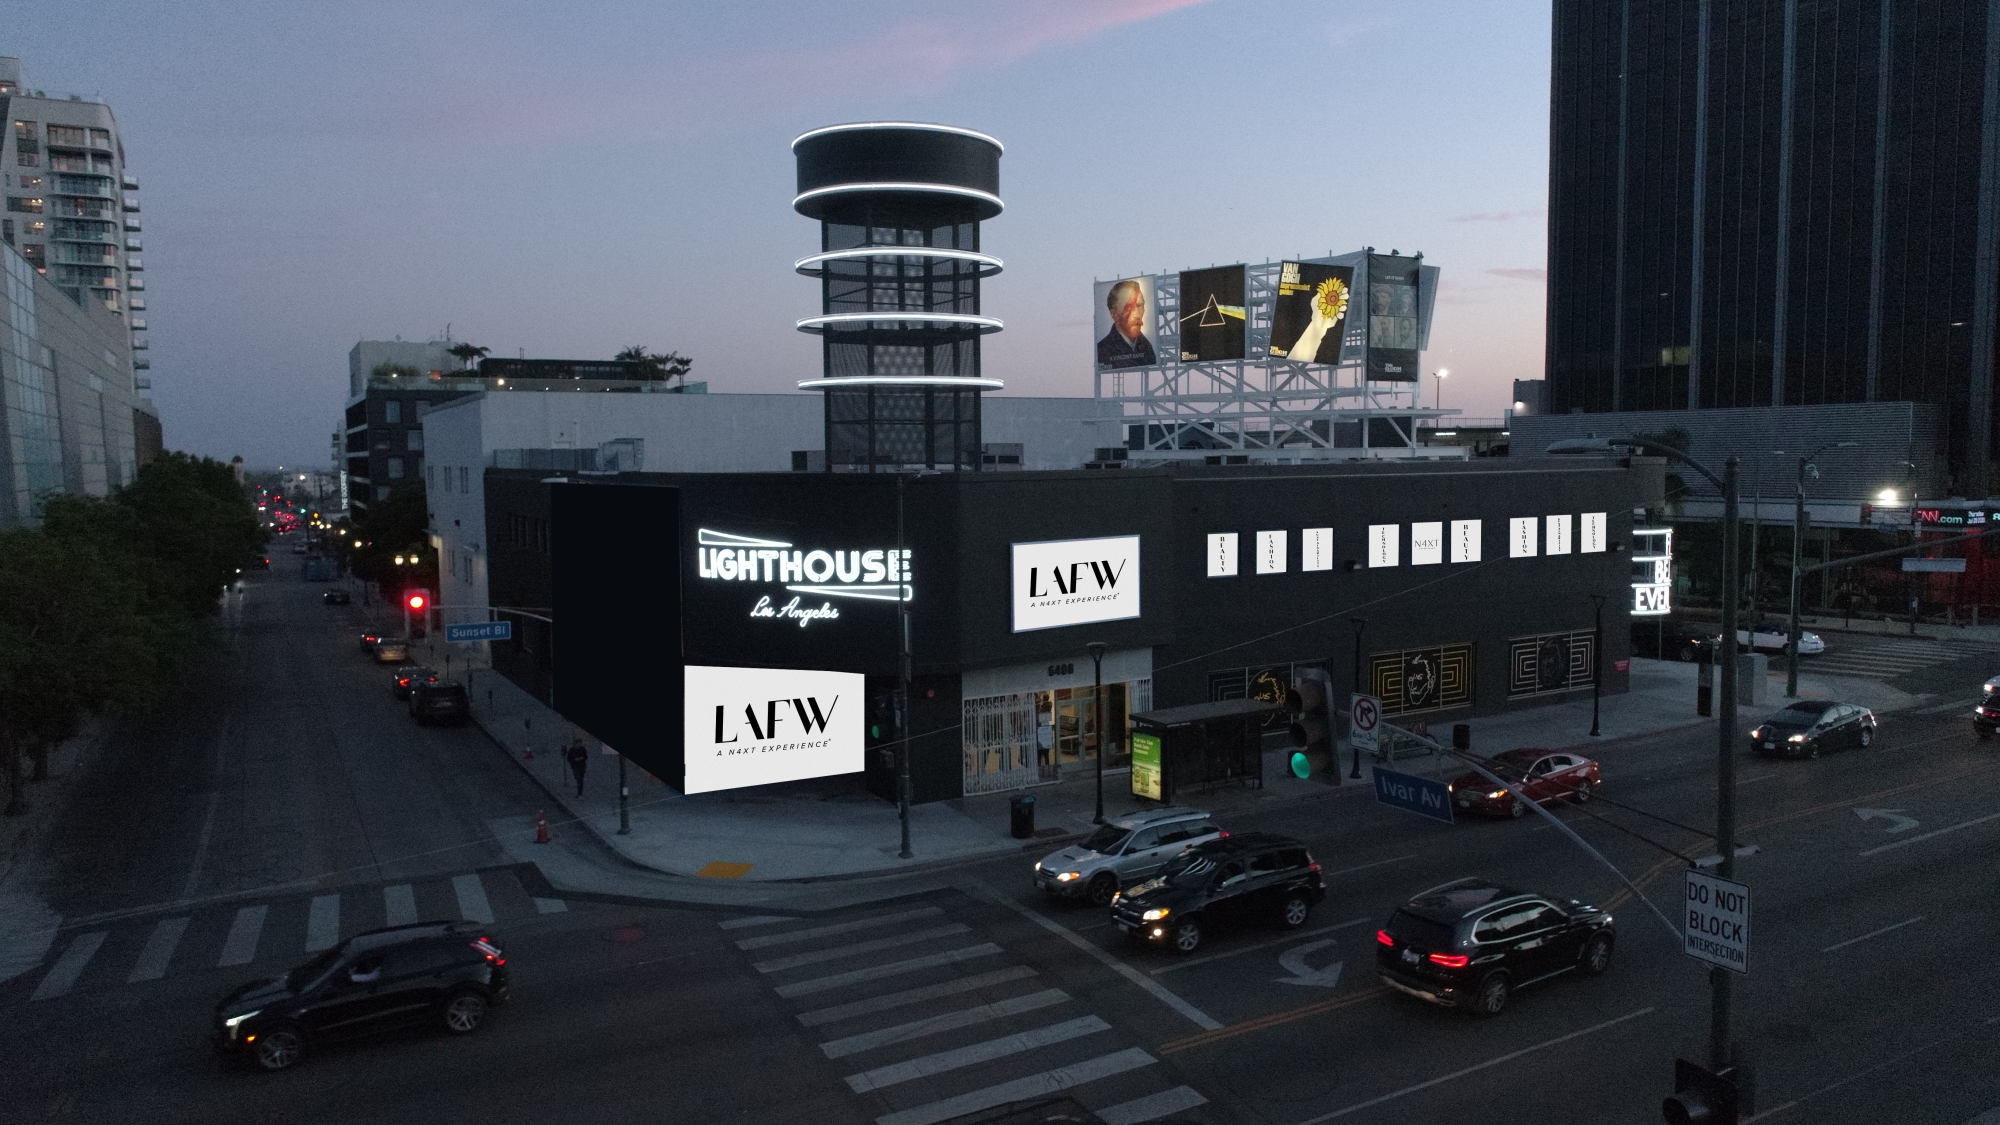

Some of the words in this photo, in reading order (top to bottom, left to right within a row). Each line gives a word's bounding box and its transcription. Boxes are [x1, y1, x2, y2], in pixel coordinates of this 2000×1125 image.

[1281, 272, 1301, 284] GOGH
[1283, 262, 1299, 274] VAN
[1414, 539, 1440, 548] N4XT
[698, 547, 912, 583] LIGHTHOUSE
[1029, 558, 1126, 598] LAFW
[750, 596, 774, 618] Los
[776, 596, 840, 628] Angeles
[1039, 599, 1062, 607] N4XT
[452, 627, 491, 638] Sunset
[494, 625, 506, 635] Bl
[714, 694, 840, 744] LAFW
[728, 746, 757, 756] N4XT
[1381, 776, 1415, 802] Ivar
[1421, 787, 1441, 808] Av
[1688, 881, 1709, 905] DO
[1715, 888, 1746, 915] NOT
[1689, 909, 1743, 944] BLOCK
[1687, 934, 1745, 964] INTERSECTION
